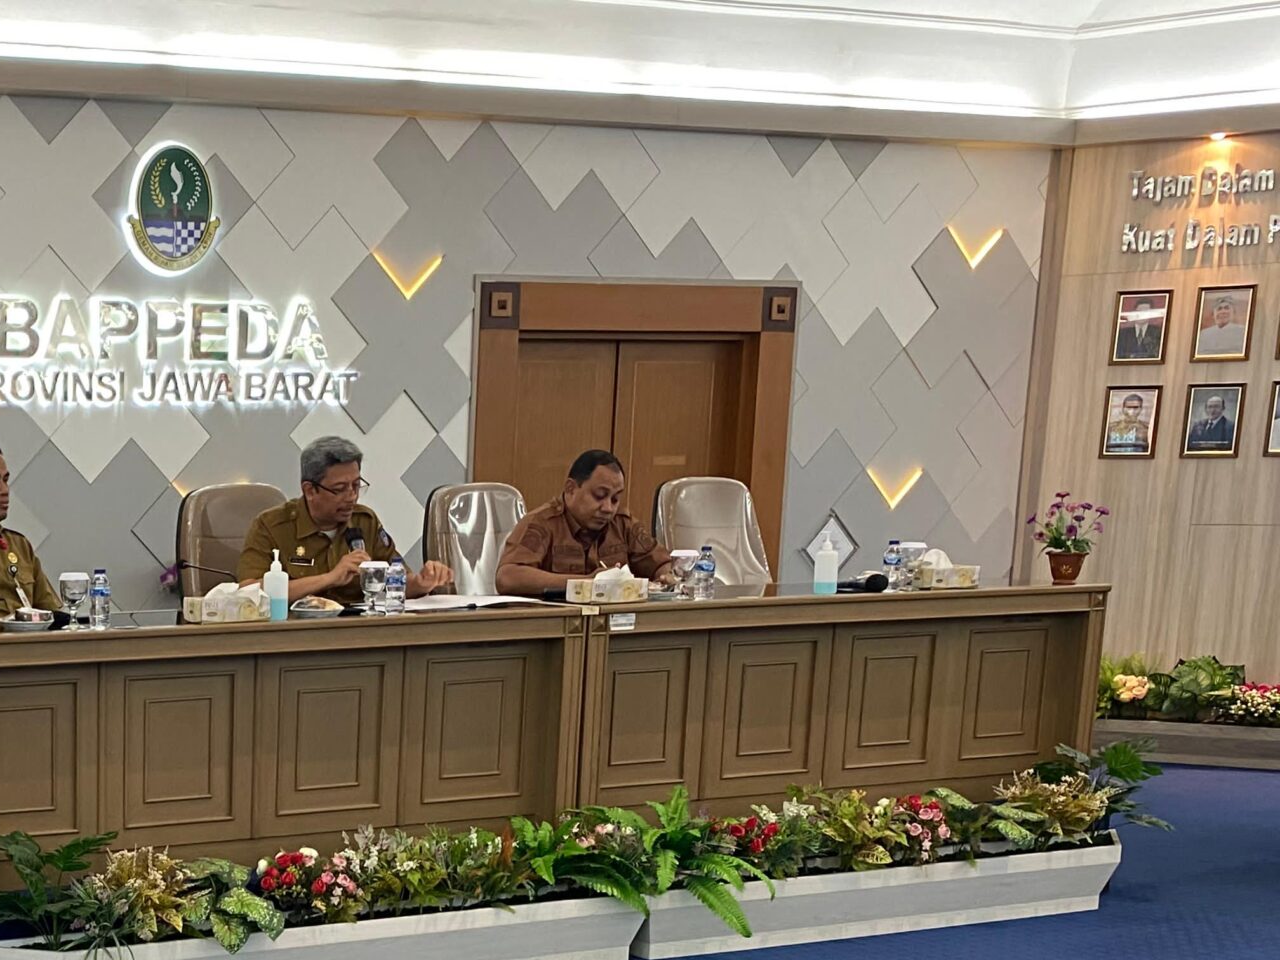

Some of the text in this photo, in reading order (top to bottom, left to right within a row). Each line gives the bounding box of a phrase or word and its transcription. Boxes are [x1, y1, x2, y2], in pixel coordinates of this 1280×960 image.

[1129, 169, 1196, 203] Tajam
[1121, 221, 1175, 253] Kuat
[1185, 216, 1260, 250] Dalam
[137, 369, 234, 403] JAWA
[243, 368, 359, 403] BARAT
